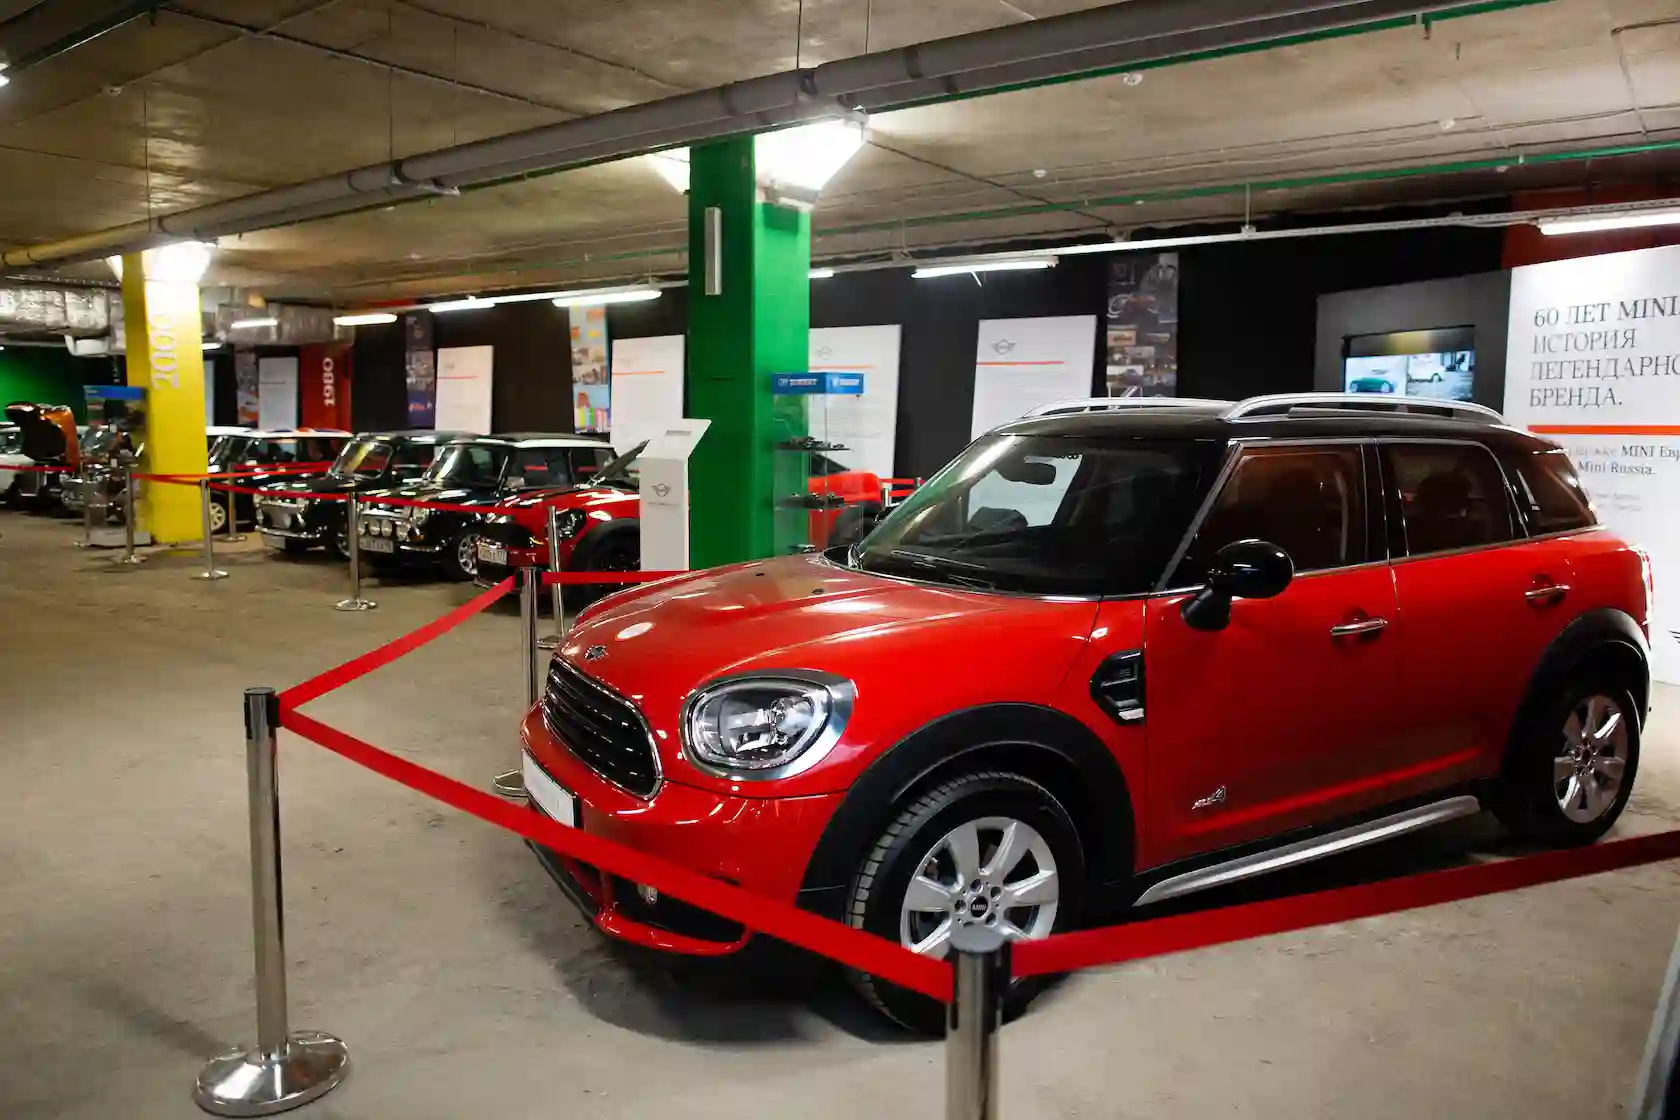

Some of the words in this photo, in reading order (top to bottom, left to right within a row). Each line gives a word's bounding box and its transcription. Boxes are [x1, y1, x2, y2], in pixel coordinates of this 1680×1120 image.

[1534, 308, 1559, 328] 60
[1566, 302, 1611, 325] ЛЕТ
[149, 312, 179, 390] 2000
[1532, 328, 1637, 354] ИСТОРИЯ
[322, 357, 336, 407] 1980
[1529, 387, 1623, 408] БРЕНДА.
[1622, 445, 1655, 458] MINI
[1578, 460, 1606, 473] Mini
